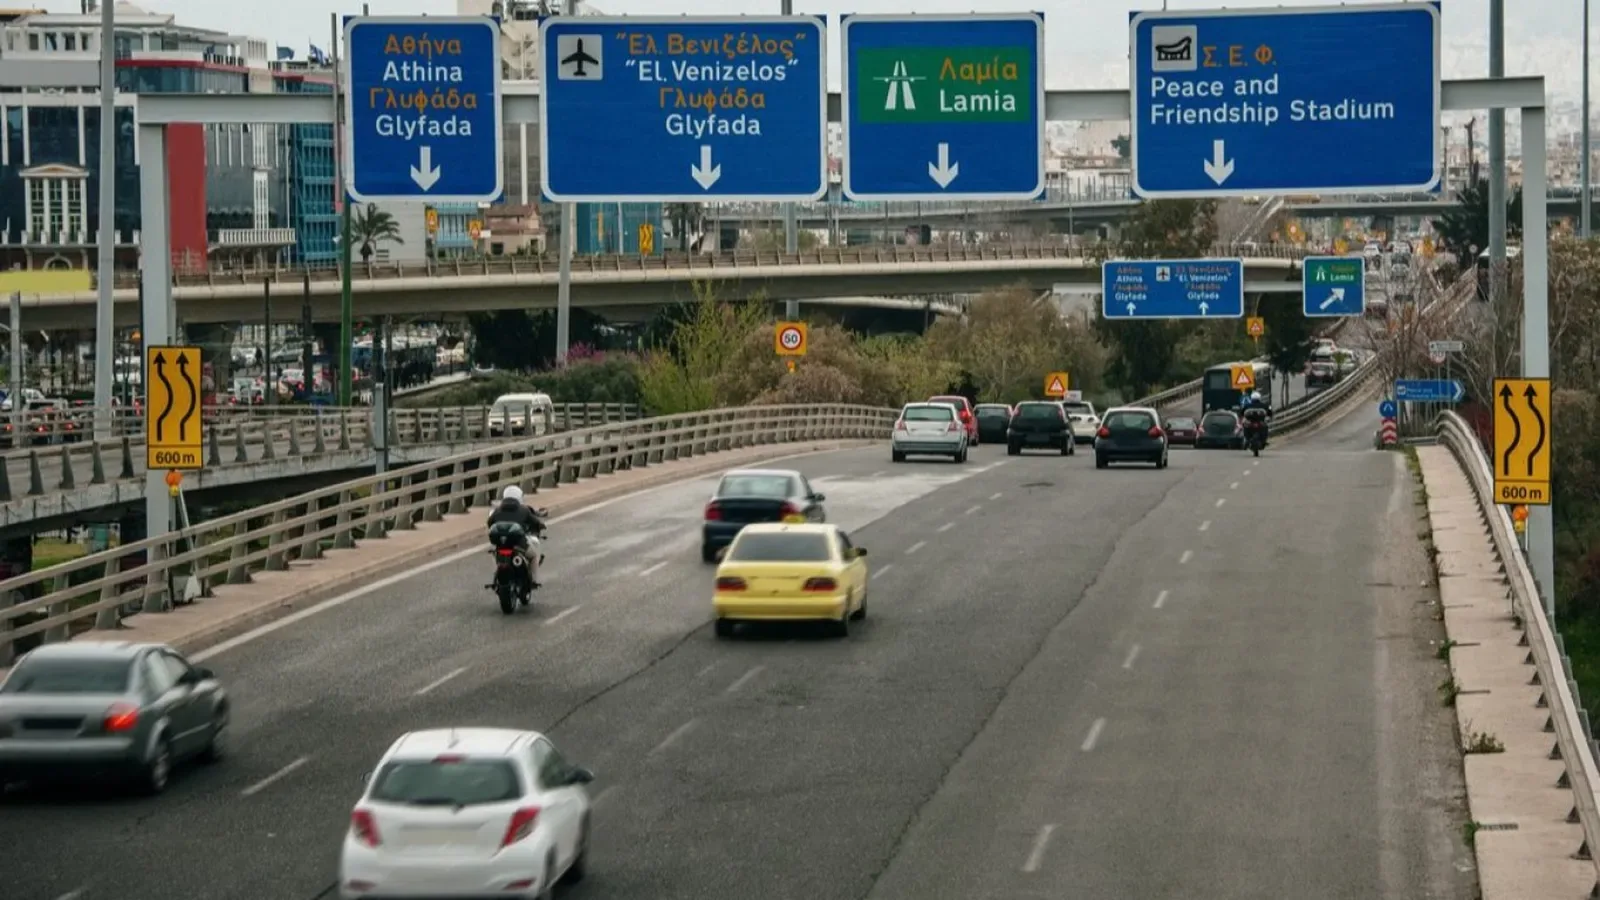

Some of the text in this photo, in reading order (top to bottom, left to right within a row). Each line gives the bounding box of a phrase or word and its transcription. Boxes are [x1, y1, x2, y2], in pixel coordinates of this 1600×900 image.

[384, 32, 461, 60] Αθήνα
[383, 60, 462, 82] Athina
[625, 59, 798, 82] "El. Venizelos"
[939, 56, 1018, 85] Λαμία
[1151, 73, 1279, 98] Peace and
[369, 87, 477, 114] Γλυφάδα
[659, 87, 766, 113] Γλυφάδα
[939, 89, 1016, 112] Lamia
[1151, 99, 1395, 125] Friendship Stadium
[376, 114, 472, 140] Glyfada
[665, 114, 761, 139] Glyfada
[784, 333, 798, 344] 50
[155, 451, 195, 464] 600 m
[1502, 486, 1542, 499] 600 m
